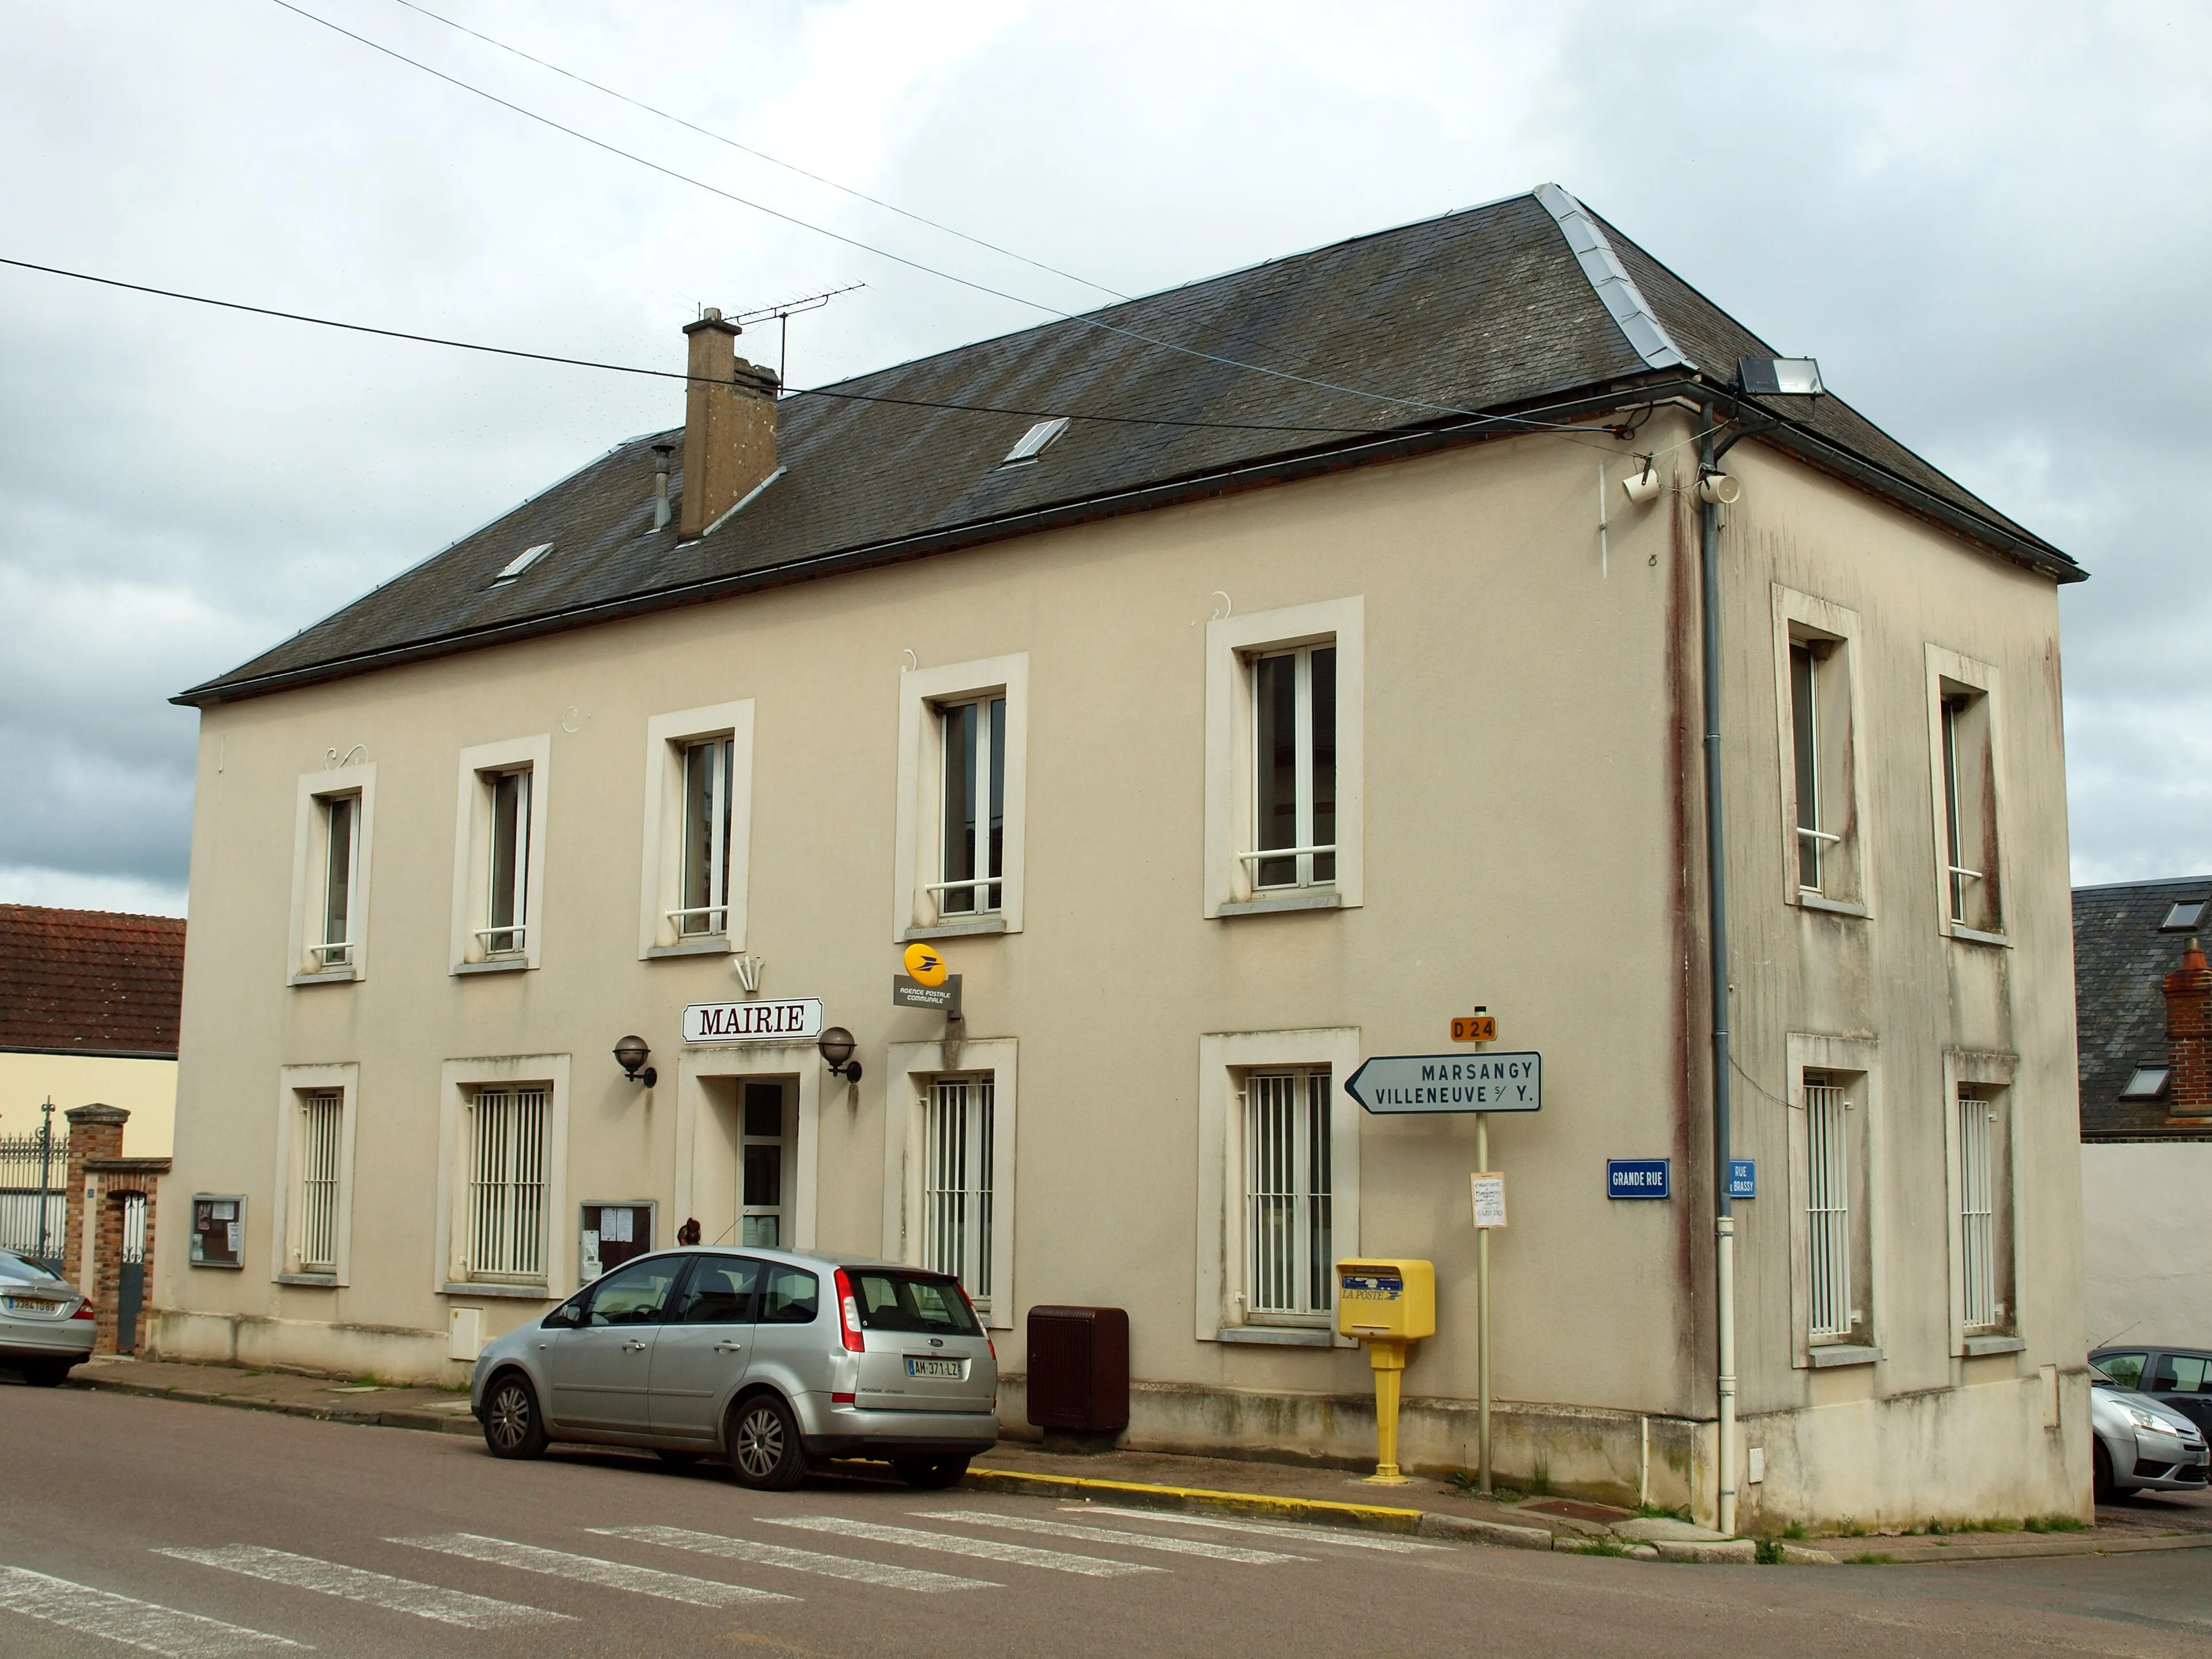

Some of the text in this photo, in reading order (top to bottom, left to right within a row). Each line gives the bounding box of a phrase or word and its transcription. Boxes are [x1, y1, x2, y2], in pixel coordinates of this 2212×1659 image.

[900, 987, 950, 998] AGENCE POSTALE
[907, 995, 944, 1003] COMMUNALE
[699, 1005, 805, 1036] MAIRIE
[1455, 1021, 1493, 1037] D 24
[1422, 1062, 1532, 1081] MARSANGY
[1376, 1086, 1487, 1104] VILLENEUVE
[1735, 1166, 1747, 1177] RUE
[1613, 1172, 1662, 1186] GRANDE RUE
[1733, 1181, 1753, 1192] BRASSY
[1342, 1290, 1384, 1300] LA POSTE
[915, 1361, 957, 1376] AM-371-LZ
